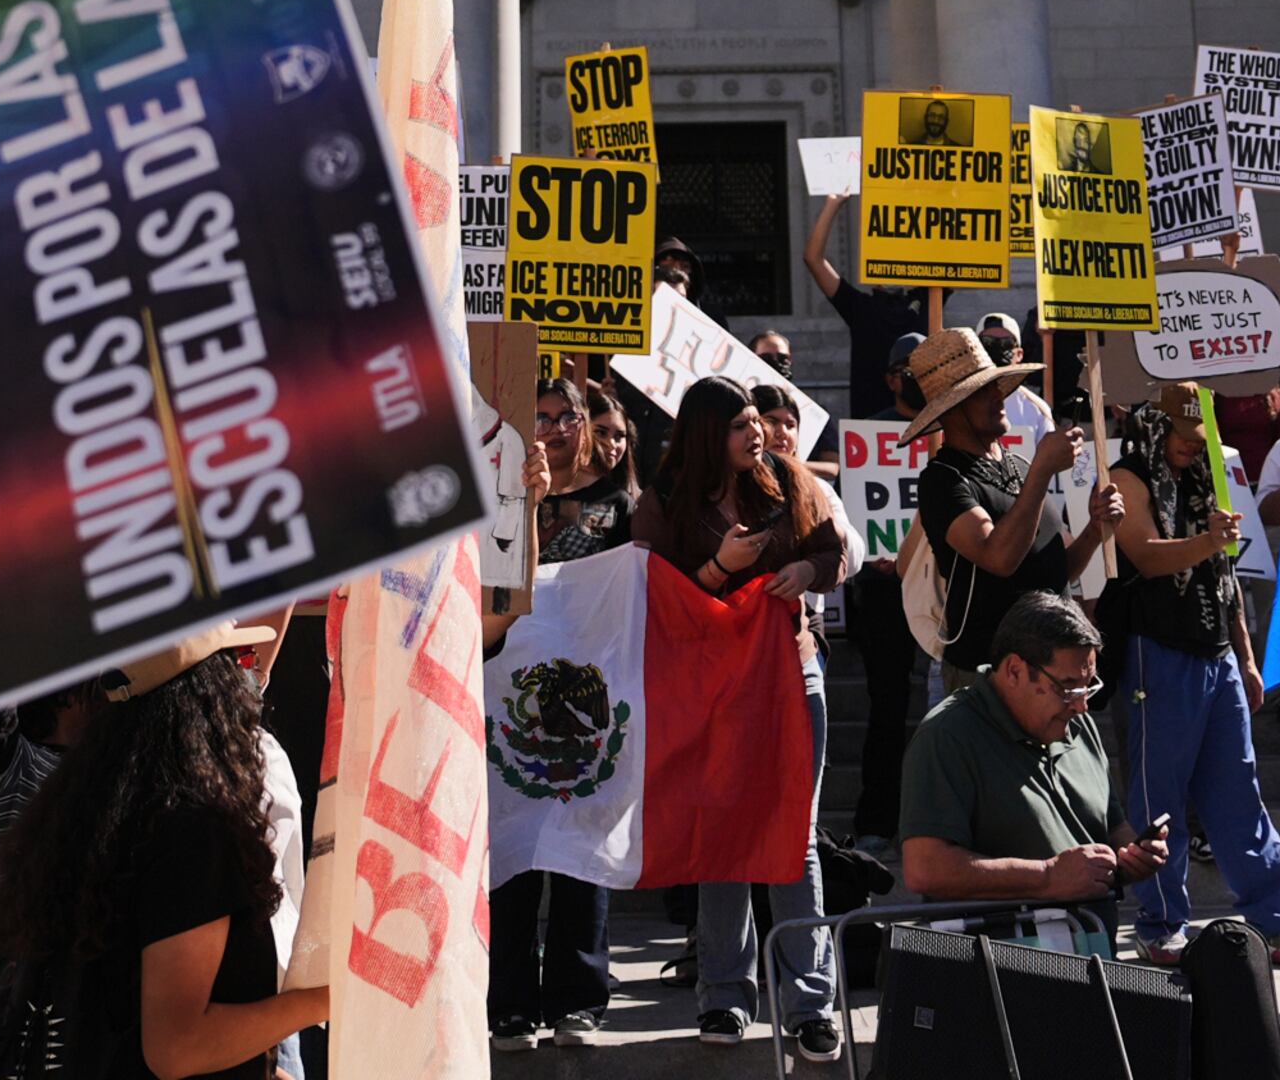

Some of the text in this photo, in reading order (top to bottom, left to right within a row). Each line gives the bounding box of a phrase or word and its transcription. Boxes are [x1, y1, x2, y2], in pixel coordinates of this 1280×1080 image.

[1207, 50, 1237, 75] THE
[570, 53, 643, 114] STOP
[575, 120, 649, 151] ICE TERROR
[1162, 100, 1215, 133] WHOLE
[110, 78, 227, 201] DE
[1144, 124, 1219, 152] YSTEM
[1155, 137, 1217, 176] GUILTY
[868, 147, 1003, 184] JUSTICE FOR
[516, 164, 647, 244] STOP
[1038, 173, 1143, 215] JUSTICE FOR
[12, 149, 131, 322] POR
[867, 204, 1002, 243] ALEX PRETTI
[331, 232, 378, 309] SEIU
[867, 262, 1000, 281] PARTY FOR SOCIALISM & LIBERATION
[1042, 238, 1147, 280] ALEX PRETTI
[511, 260, 643, 299] ICE TERROR
[1188, 289, 1236, 305] NEVER
[1243, 288, 1253, 304] A
[510, 298, 643, 326] NOW!
[1213, 311, 1262, 330] JUST
[1153, 330, 1272, 361] TO EXIST!
[139, 189, 316, 594] ESCUELAS
[365, 344, 423, 431] UTLA
[44, 314, 194, 633] UNIDOS
